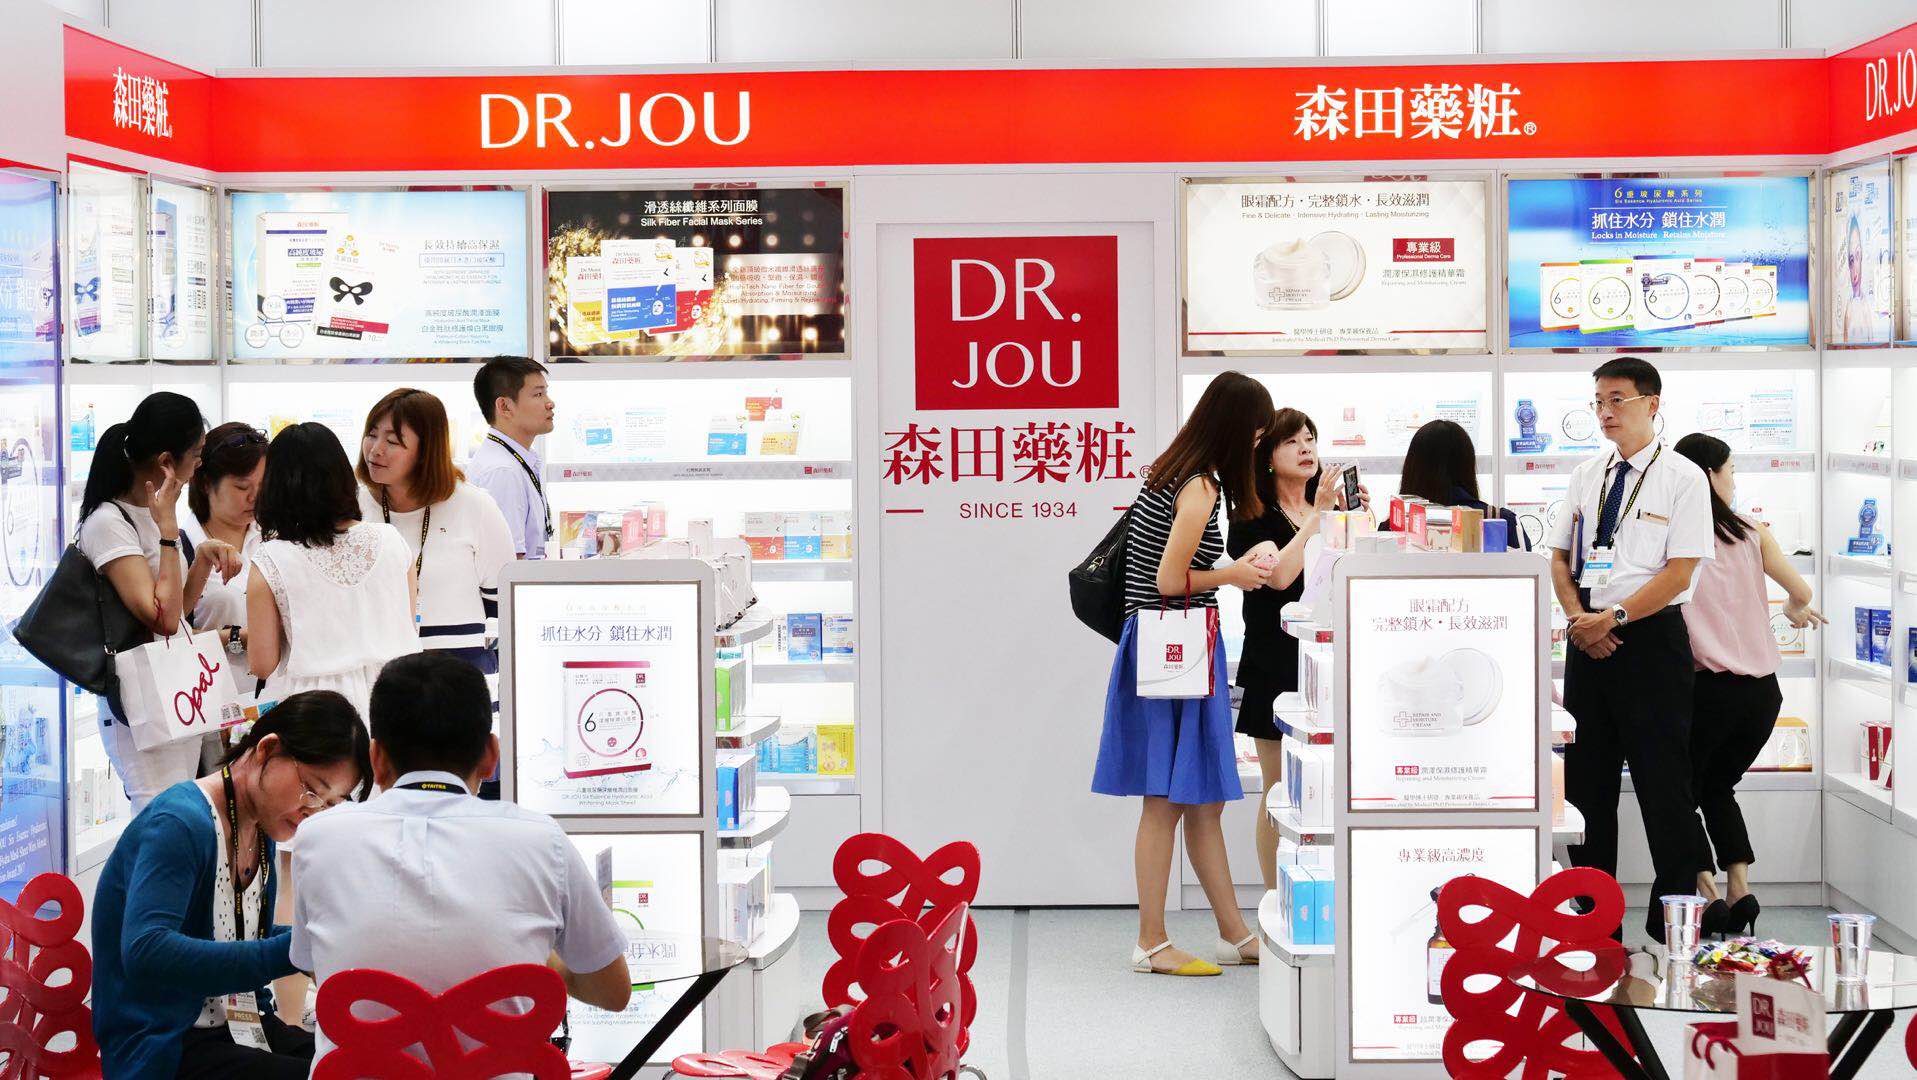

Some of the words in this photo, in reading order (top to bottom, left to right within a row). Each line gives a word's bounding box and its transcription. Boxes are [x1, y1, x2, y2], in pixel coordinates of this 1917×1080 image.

[640, 216, 656, 226] Silk
[659, 216, 680, 226] Fiber
[683, 216, 708, 226] Facial
[710, 216, 733, 226] Mask
[736, 216, 763, 226] Series
[1592, 210, 1655, 229] 抓住水分
[1662, 209, 1726, 229] 鎖住水潤
[1592, 231, 1614, 239] Locks
[1624, 231, 1658, 239] Moisture
[1407, 241, 1441, 253] 專業級
[951, 258, 1081, 323] DR.
[952, 340, 1081, 389] JOU
[960, 502, 1023, 519] SINCE
[1032, 502, 1078, 518] 1934
[541, 625, 602, 642] 抓住水分
[609, 625, 672, 642] 鎖住水潤
[174, 652, 220, 726] Opal
[585, 712, 597, 733] 6
[234, 1010, 253, 1022] PRESS
